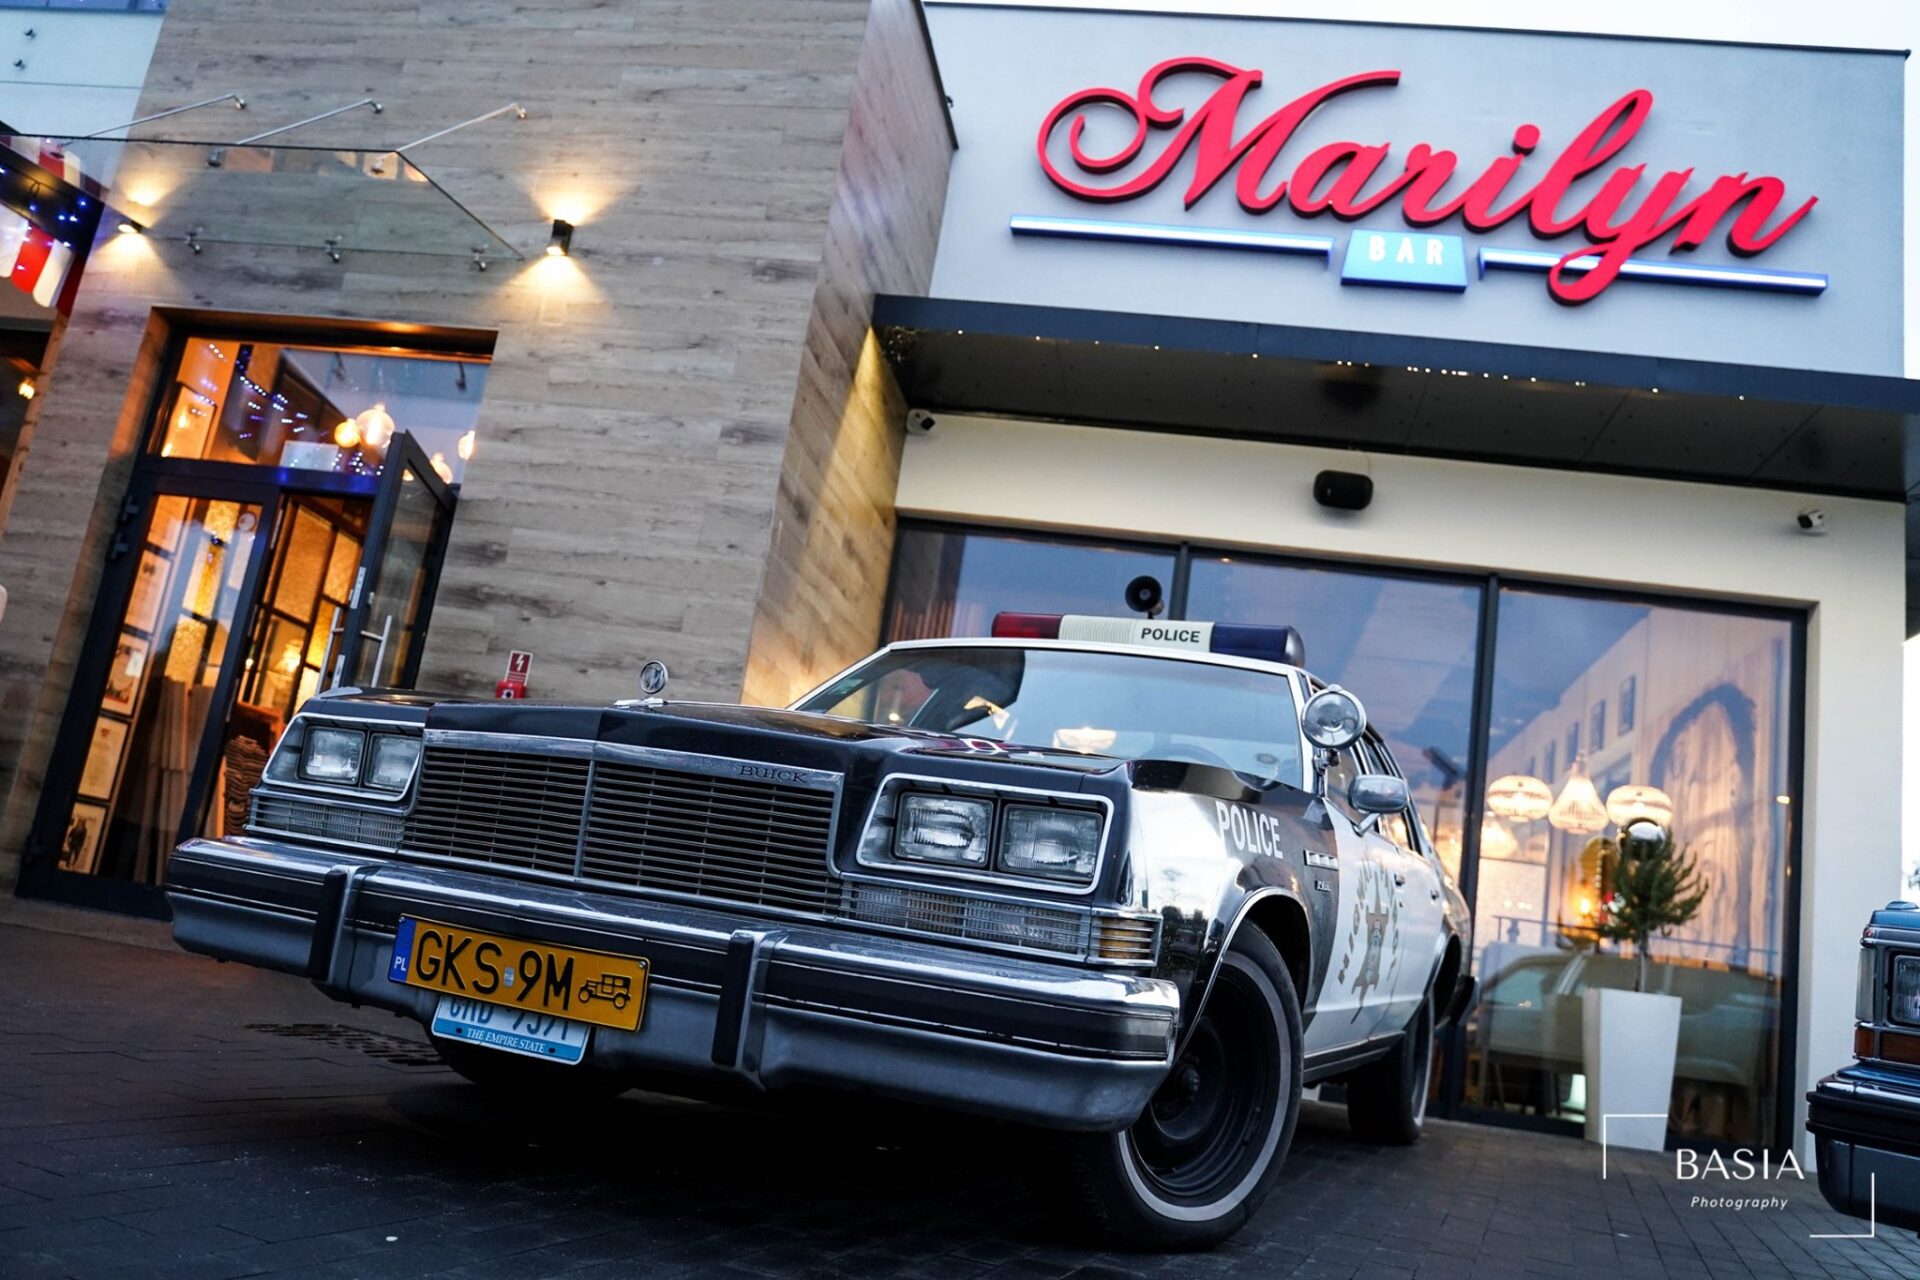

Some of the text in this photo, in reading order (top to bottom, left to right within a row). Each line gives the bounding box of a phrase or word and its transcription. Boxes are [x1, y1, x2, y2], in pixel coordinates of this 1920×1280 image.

[1036, 56, 1819, 308] Marilyn
[1367, 234, 1444, 266] BAR
[1141, 627, 1201, 643] POLICE
[739, 765, 807, 783] BUICK
[1215, 800, 1284, 860] POLICE
[393, 955, 407, 973] PL
[415, 929, 575, 1012] GKS 9M
[466, 1027, 546, 1054] THE EMPIRE STATE
